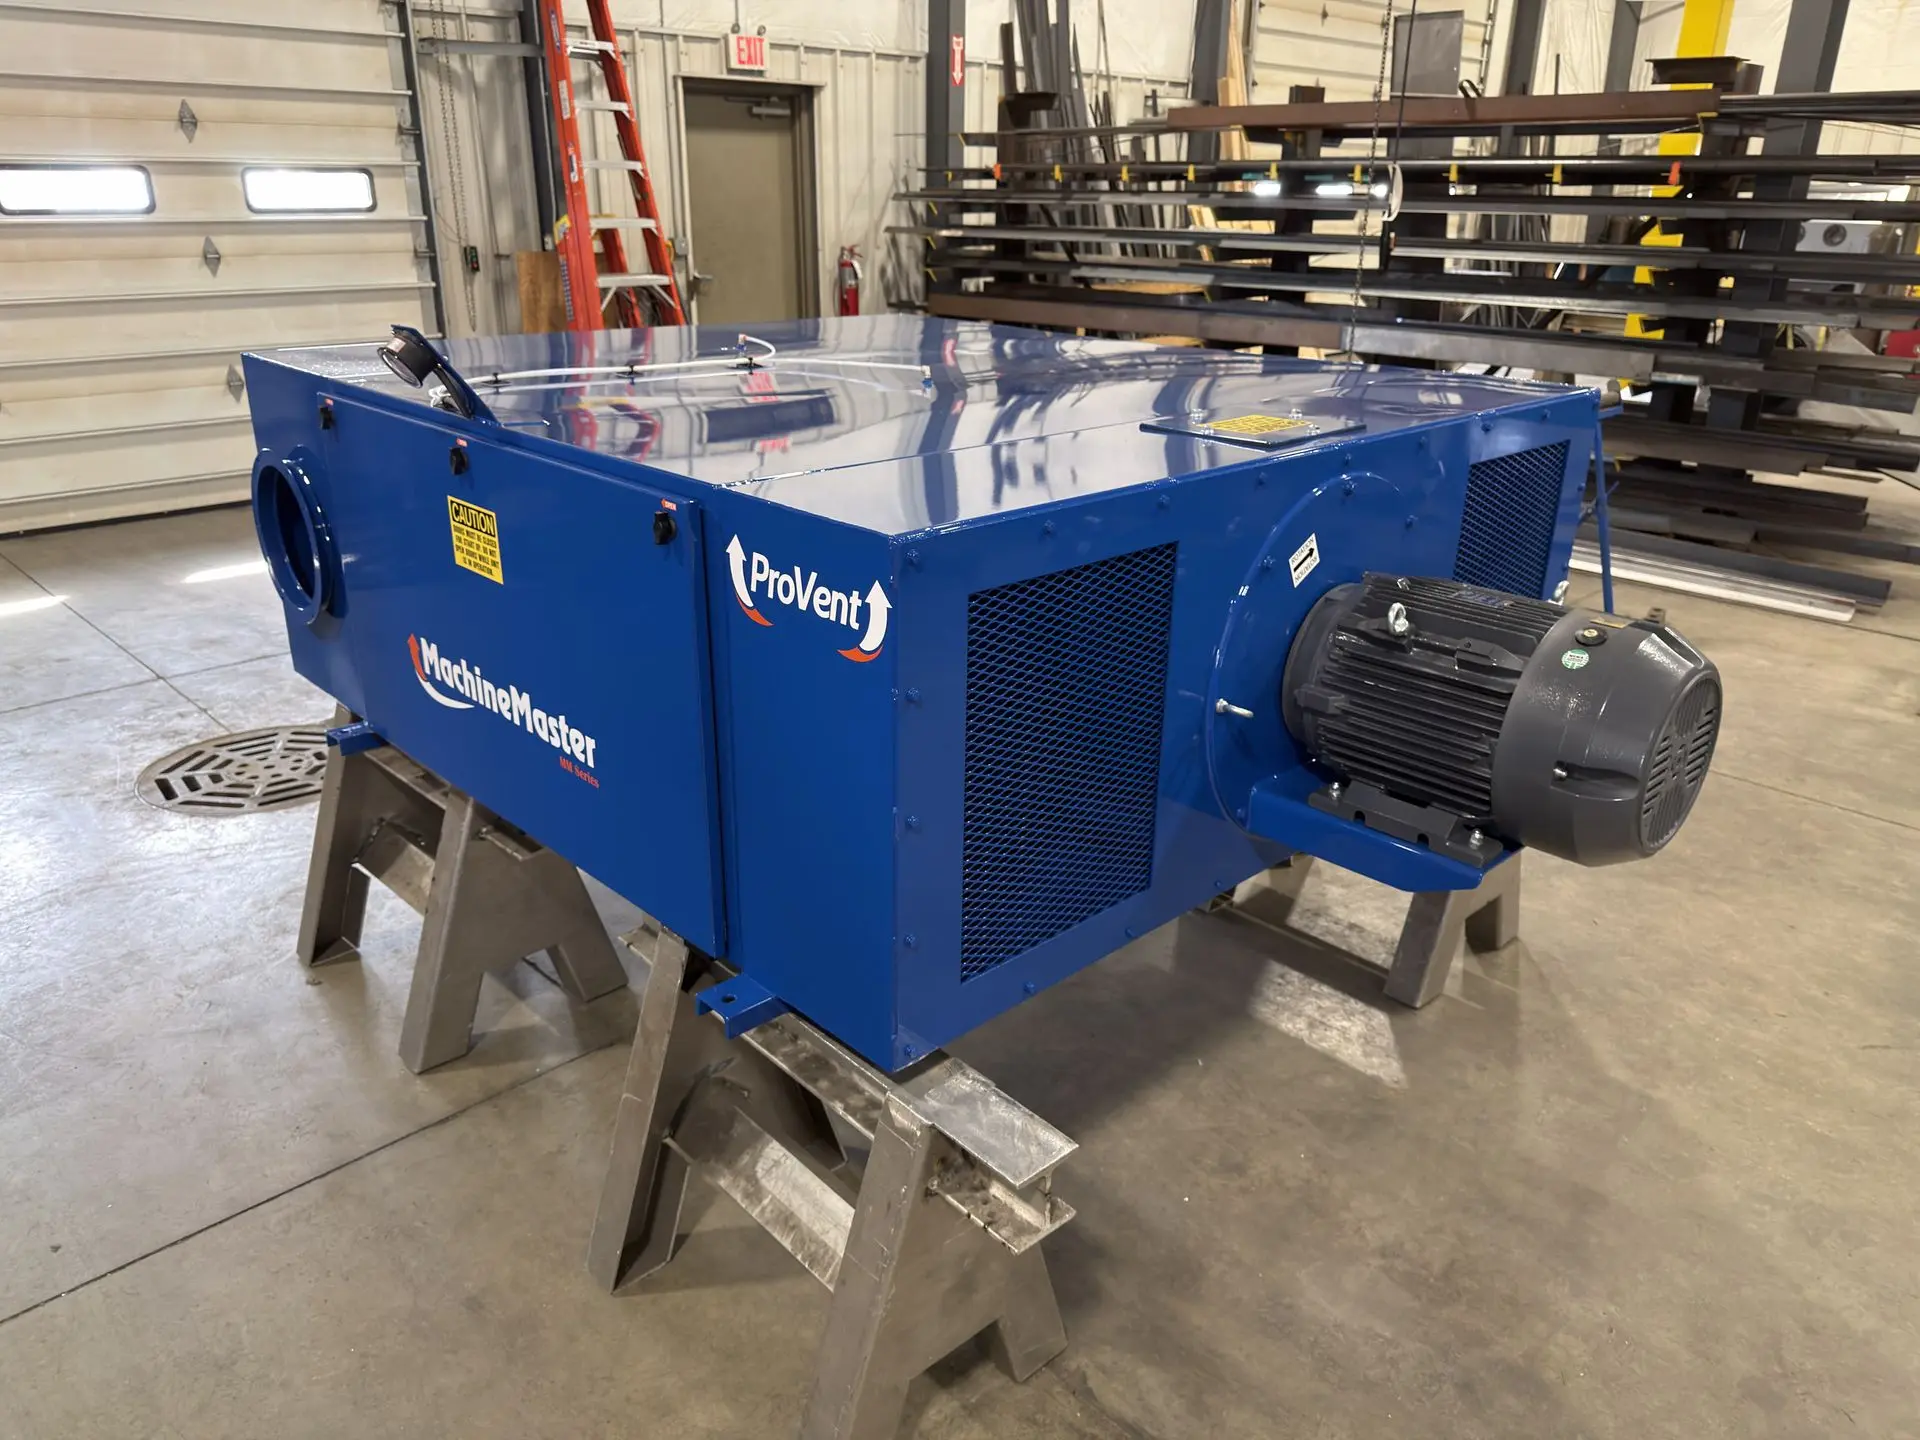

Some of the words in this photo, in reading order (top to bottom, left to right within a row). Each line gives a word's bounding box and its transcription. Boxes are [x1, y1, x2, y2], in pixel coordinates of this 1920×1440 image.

[736, 36, 764, 66] EXIT
[452, 502, 494, 535] CAUTION
[750, 551, 863, 631] ProVent
[420, 637, 596, 768] MachineMaster
[575, 765, 600, 789] Series
